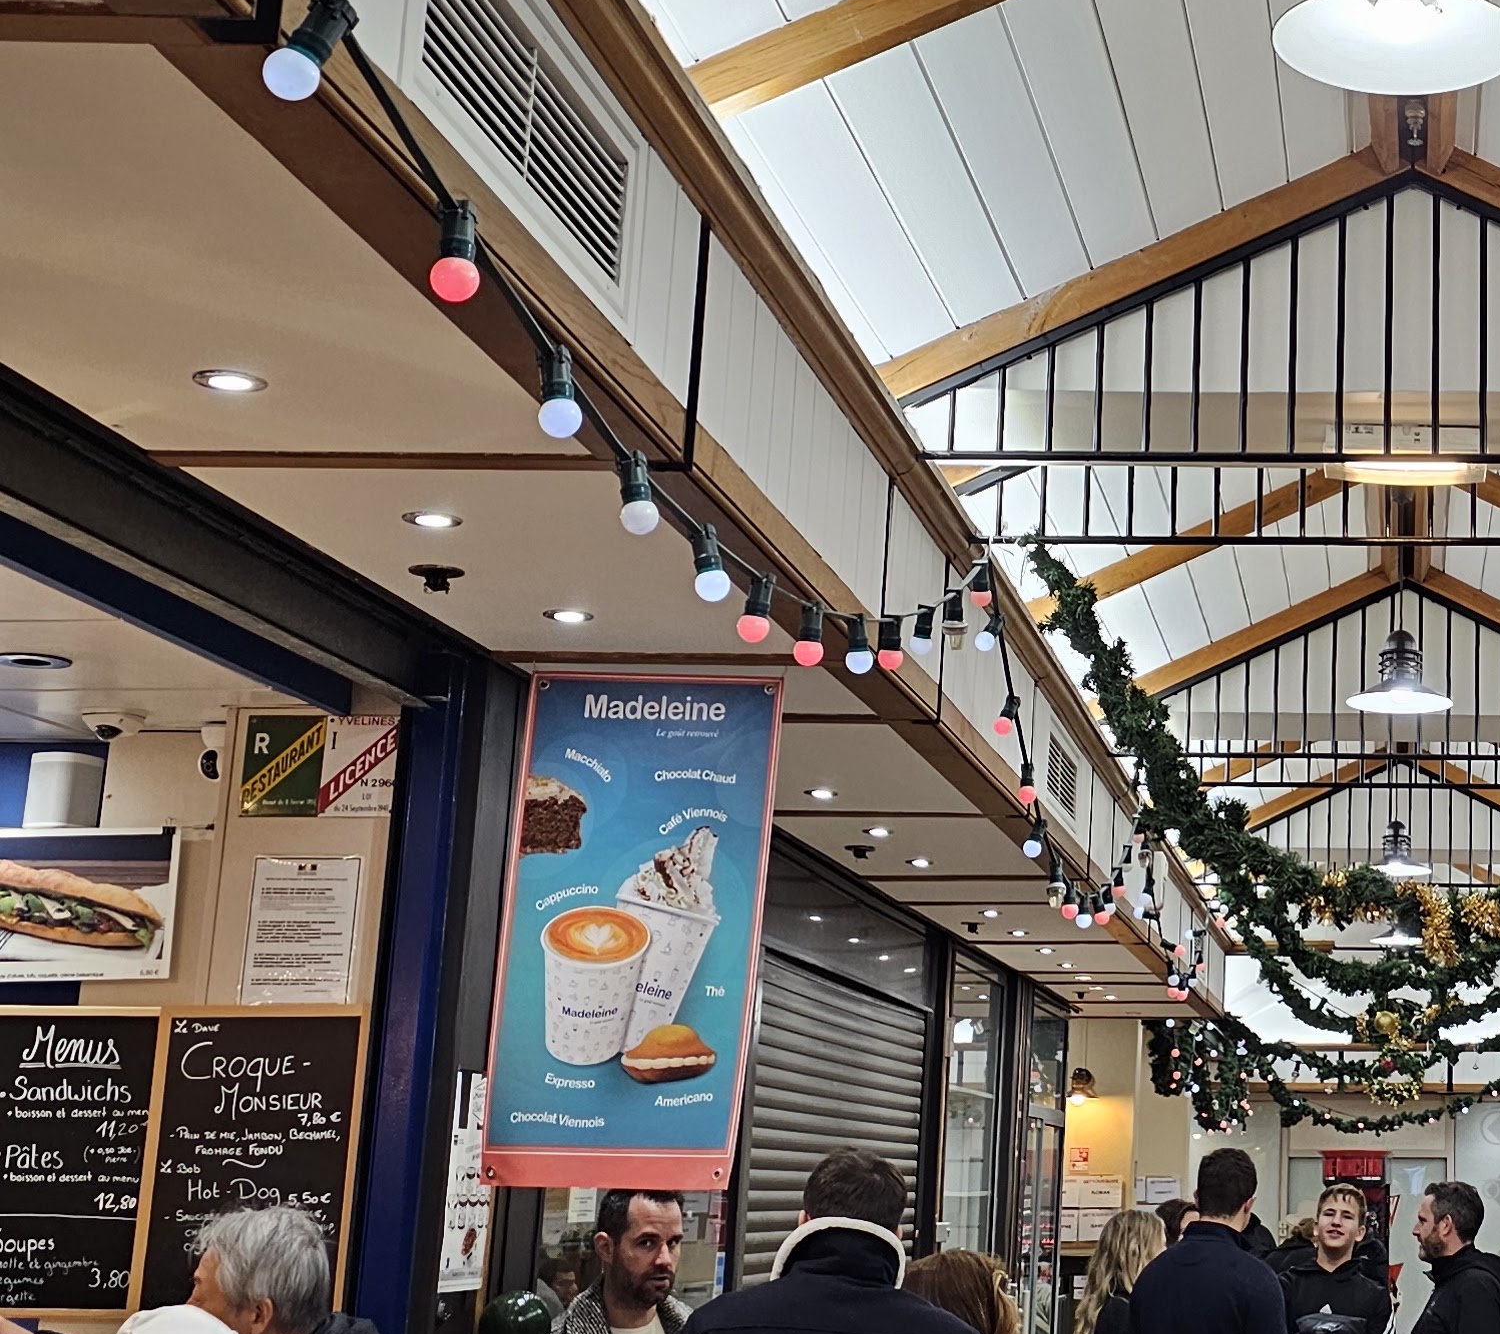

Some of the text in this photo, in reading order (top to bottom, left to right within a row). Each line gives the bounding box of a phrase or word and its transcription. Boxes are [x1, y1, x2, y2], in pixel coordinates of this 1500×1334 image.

[583, 694, 726, 722] Madeleine
[339, 717, 395, 726] YVELINES
[254, 733, 270, 754] R
[241, 725, 324, 804] RESTAURANT
[329, 729, 397, 800] LICENCE
[564, 748, 612, 783] Macchiato
[371, 778, 394, 787] 296
[654, 768, 736, 784] Chocolat Chaud
[659, 807, 728, 835] Café Viennois
[535, 883, 599, 911] Cappuccino
[705, 985, 726, 997] Thé
[562, 1006, 618, 1019] Madeleine
[22, 1024, 121, 1069] Menus
[10, 1076, 131, 1103] Sandwichs
[545, 1072, 595, 1089] Expresso
[214, 1082, 322, 1120] MONSIEUR
[654, 1092, 713, 1107] Americano
[15, 1106, 52, 1118] boisson
[56, 1108, 65, 1118] et
[71, 1106, 107, 1118] dessert
[297, 1112, 341, 1127] 7,80 €
[510, 1111, 605, 1128] Chocolat Viennois
[5, 1143, 64, 1169] Pâtes
[10, 1172, 44, 1182] boisson
[47, 1172, 56, 1182] et
[59, 1171, 92, 1182] dessert
[176, 1162, 200, 1174] Bob
[94, 1193, 137, 1212] 12,80
[0, 1228, 55, 1262] oupes
[88, 1268, 130, 1288] 3,80
